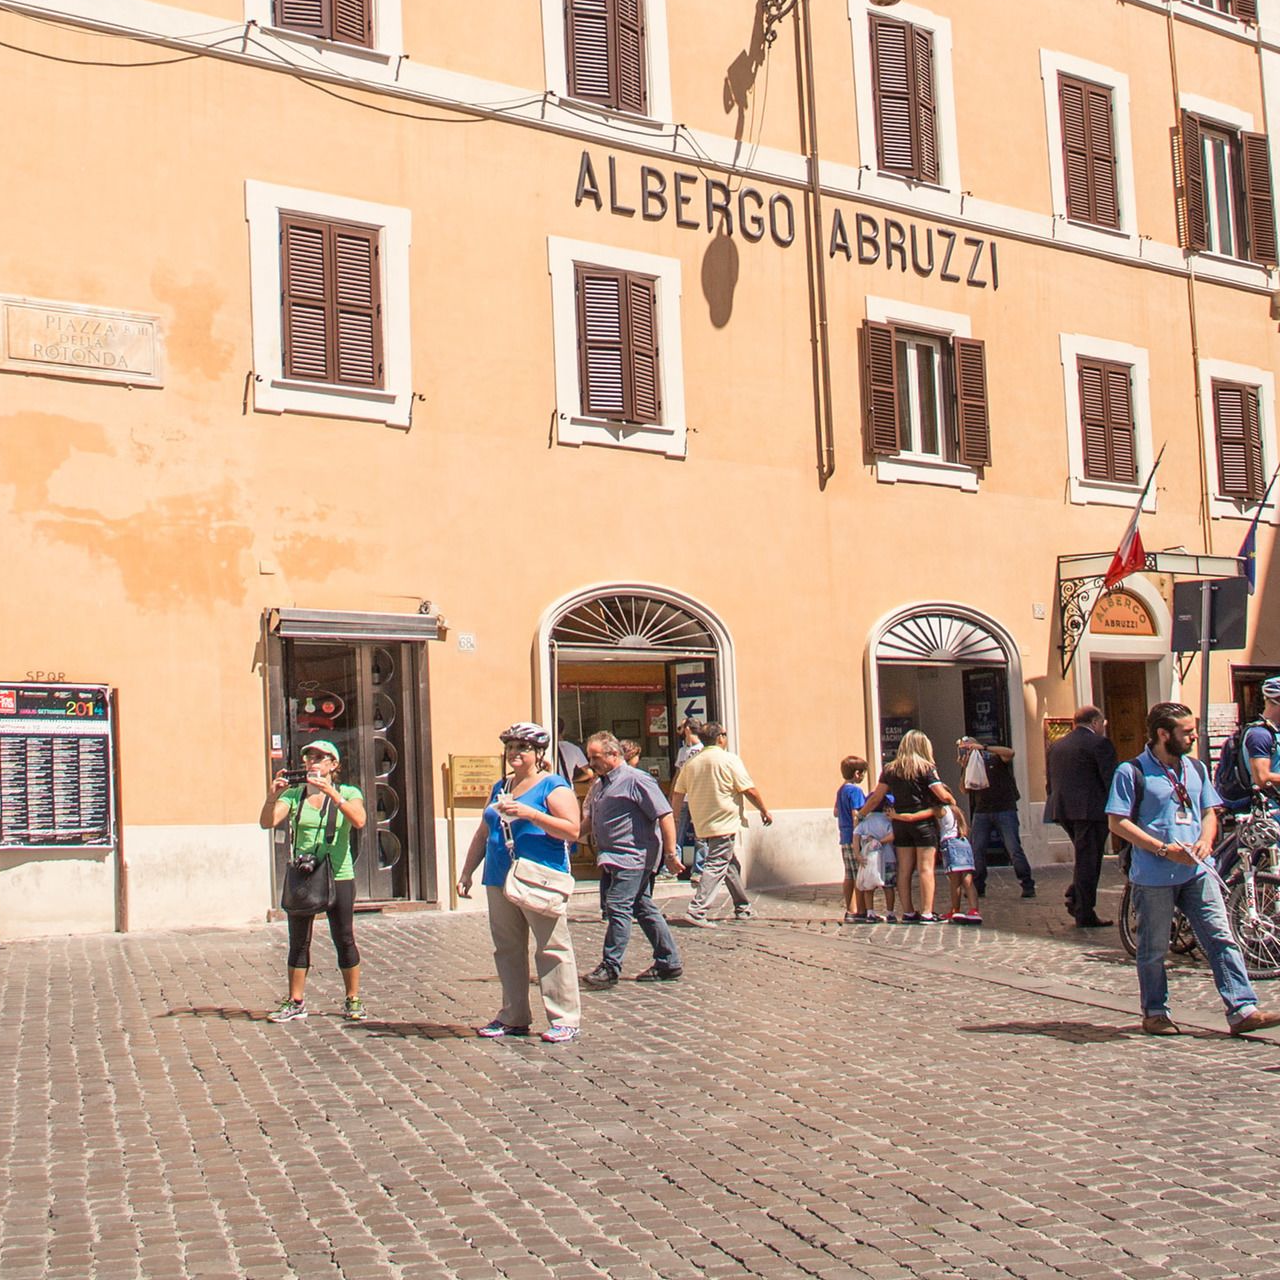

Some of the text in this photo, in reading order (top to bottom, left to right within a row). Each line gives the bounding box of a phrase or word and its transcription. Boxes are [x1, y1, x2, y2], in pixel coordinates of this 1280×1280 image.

[575, 150, 999, 291] ALBERGO ABRUZZI
[46, 315, 116, 337] PIAZZA
[59, 333, 104, 348] DELLA
[33, 344, 128, 368] ROTONDA
[1096, 596, 1147, 624] ALBERGO
[1104, 619, 1138, 629] ABRUZZI
[66, 701, 105, 716] 2014
